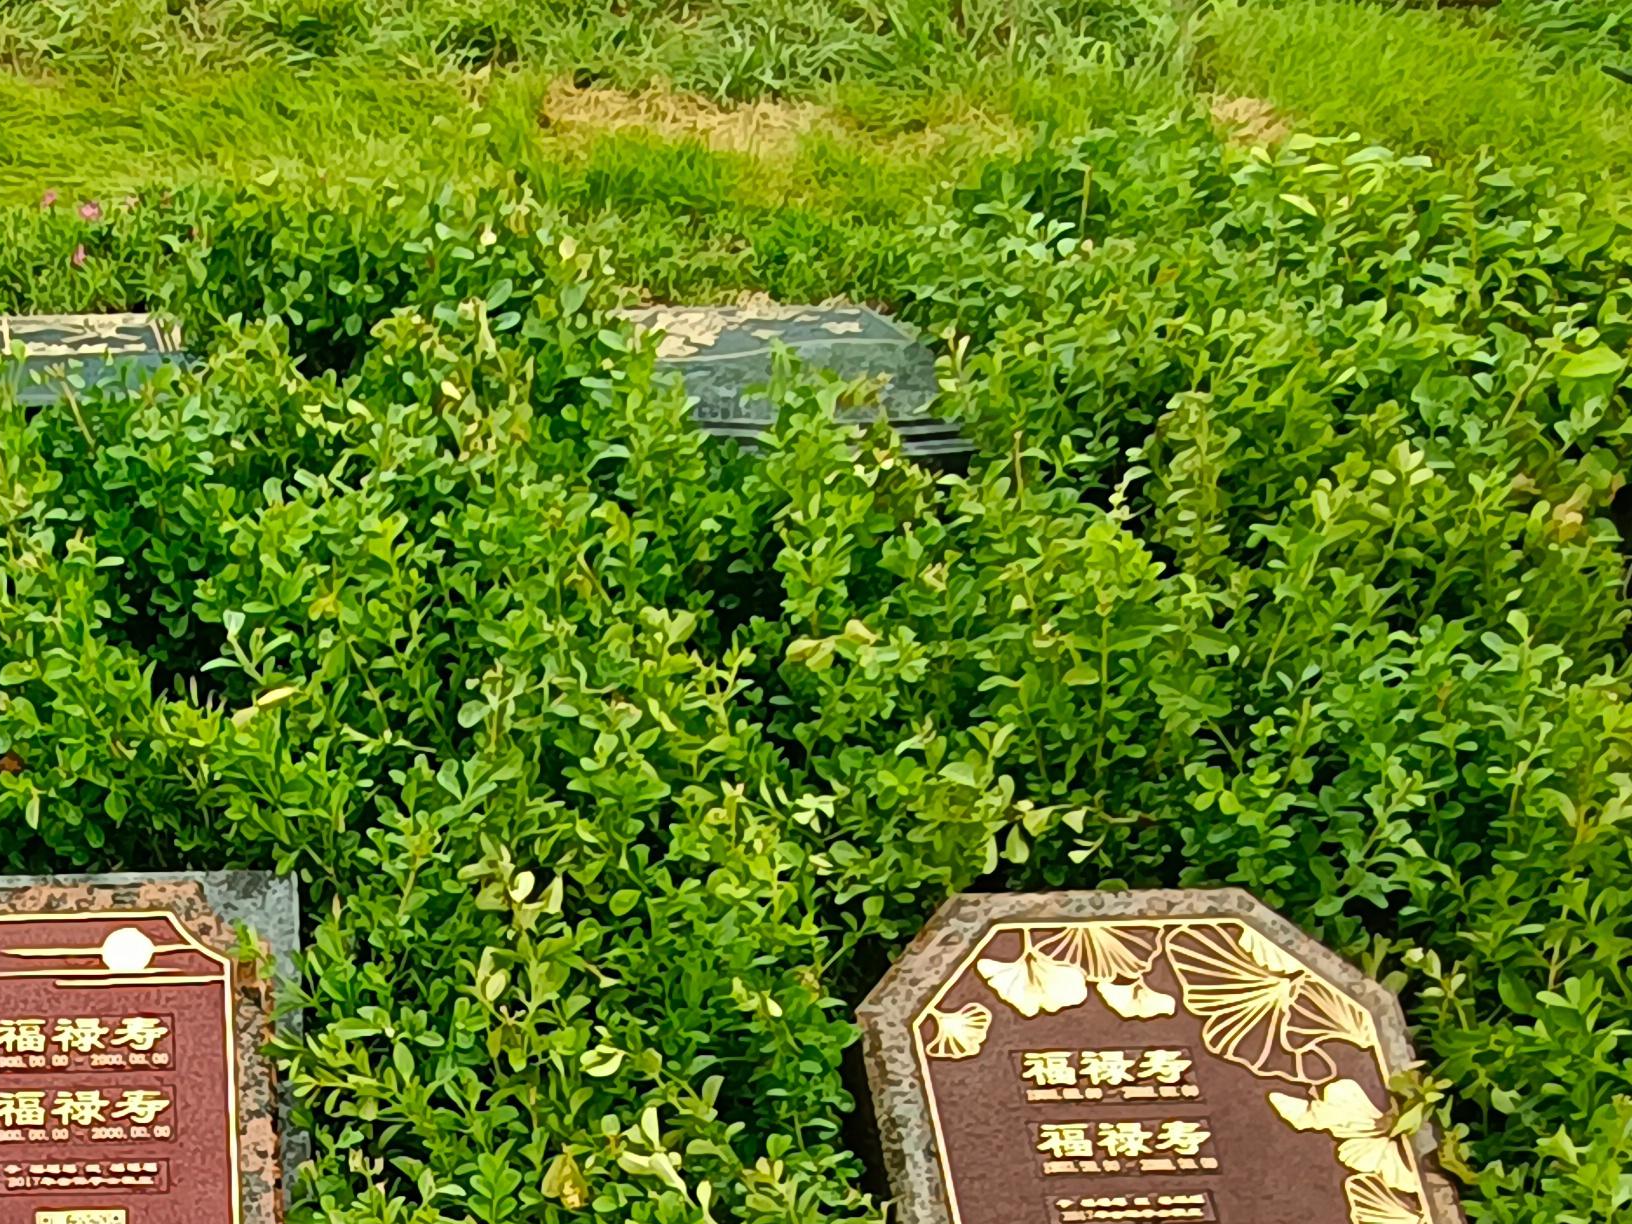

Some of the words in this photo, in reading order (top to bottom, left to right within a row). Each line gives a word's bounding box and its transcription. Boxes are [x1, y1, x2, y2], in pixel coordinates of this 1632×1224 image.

[1022, 1049, 1193, 1086] 福禄寿
[1036, 1120, 1212, 1158] 福禄寿
